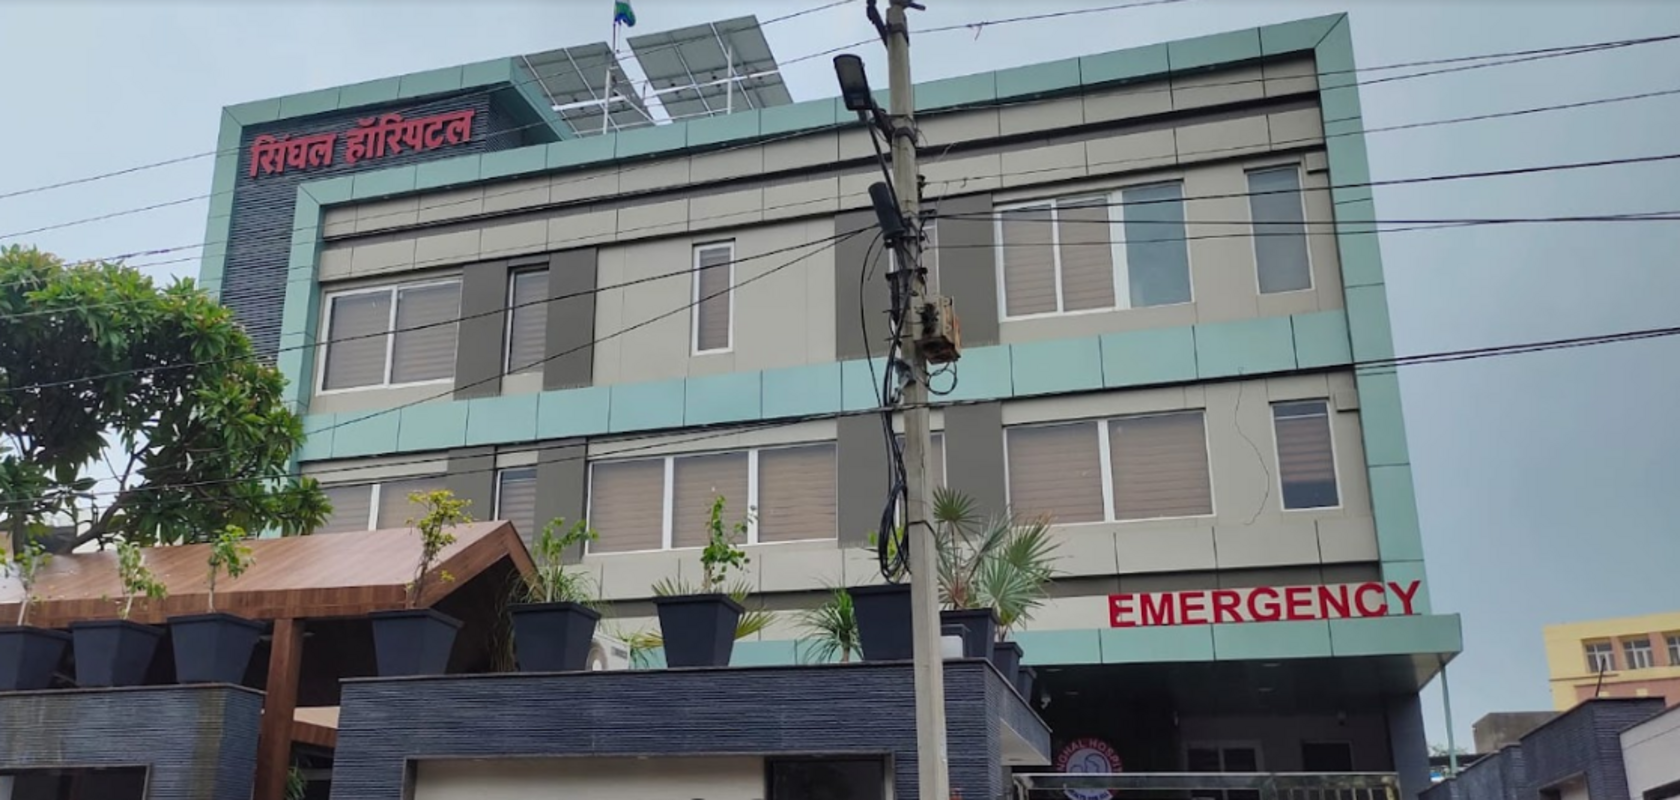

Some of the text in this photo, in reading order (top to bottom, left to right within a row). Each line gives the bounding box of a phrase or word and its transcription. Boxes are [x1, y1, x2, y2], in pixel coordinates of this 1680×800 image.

[249, 133, 336, 176] सिंघल
[1108, 580, 1421, 628] EMERGENCY
[1057, 738, 1123, 771] NGHAL HOSPIT
